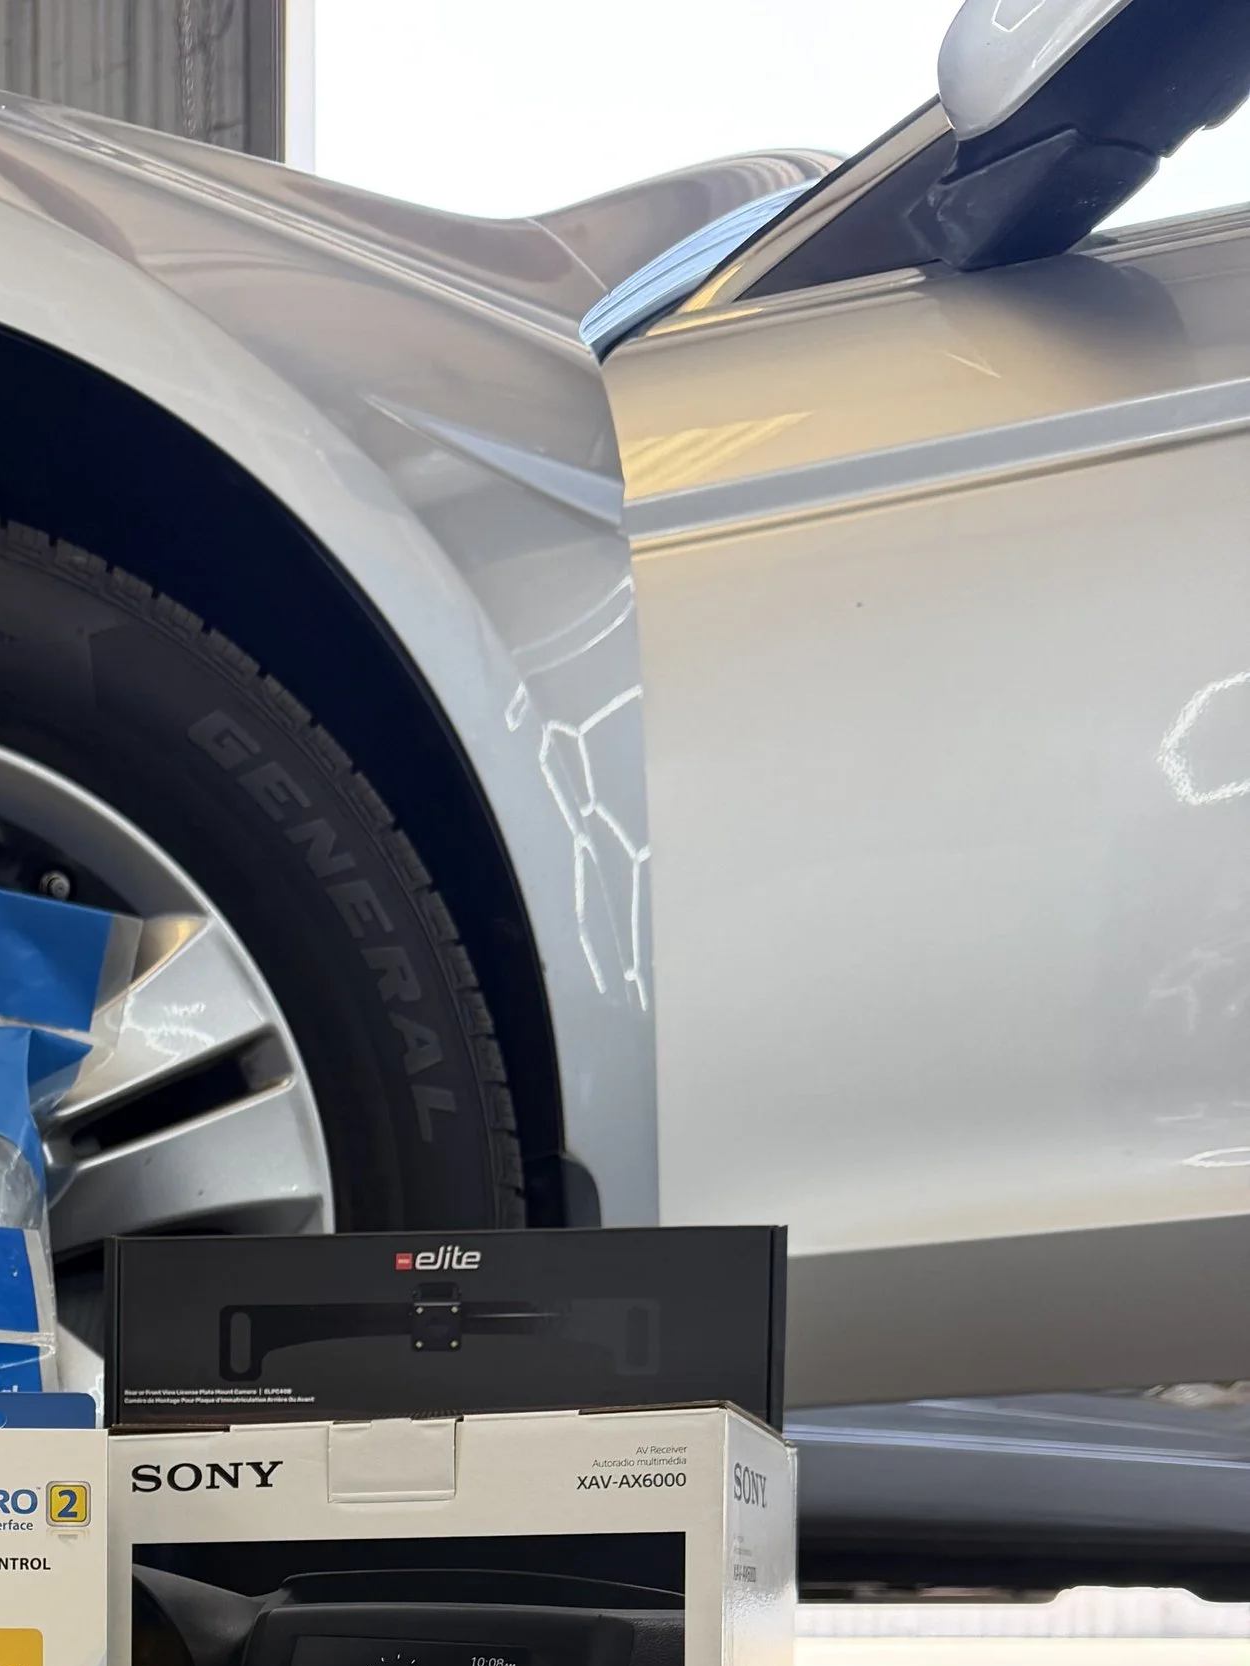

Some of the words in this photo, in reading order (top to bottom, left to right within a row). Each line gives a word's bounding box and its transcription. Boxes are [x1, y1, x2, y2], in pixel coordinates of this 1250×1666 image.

[188, 709, 456, 1143] GENERAL
[415, 1245, 481, 1270] elite
[592, 1459, 635, 1468] Autoradio
[636, 1446, 649, 1454] AV
[650, 1446, 688, 1454] Receiver
[131, 1461, 283, 1492] SONY
[576, 1472, 686, 1490] XAV-AX6000
[733, 1462, 767, 1508] SONY
[57, 1489, 78, 1518] 2
